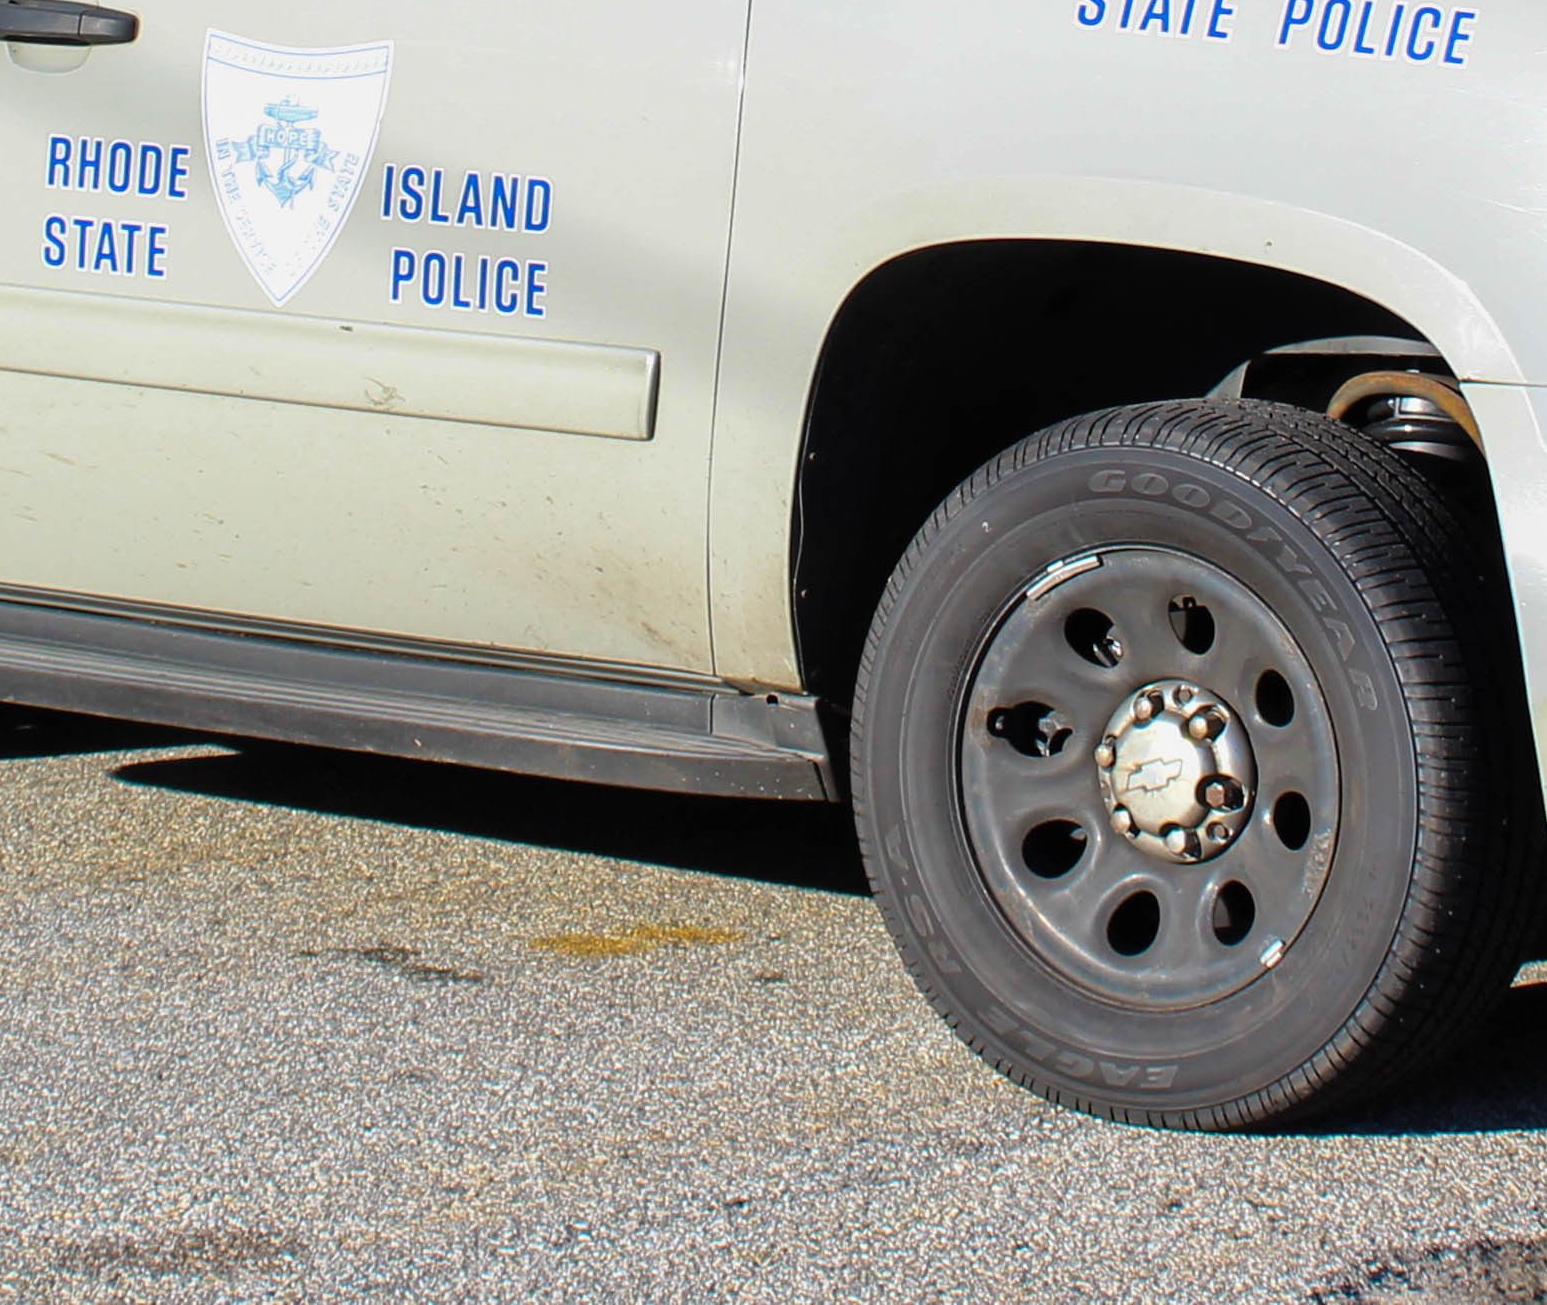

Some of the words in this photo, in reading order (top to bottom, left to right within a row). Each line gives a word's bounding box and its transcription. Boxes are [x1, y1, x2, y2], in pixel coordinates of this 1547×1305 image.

[264, 128, 311, 146] HOPE
[47, 136, 189, 199] RHODE
[383, 166, 551, 232] ISLAND
[327, 152, 359, 212] STATE
[44, 216, 167, 278] STATE
[391, 250, 547, 316] POLICE
[1088, 469, 1378, 711] GOODYEAR
[977, 1006, 1179, 1089] EAGLE
